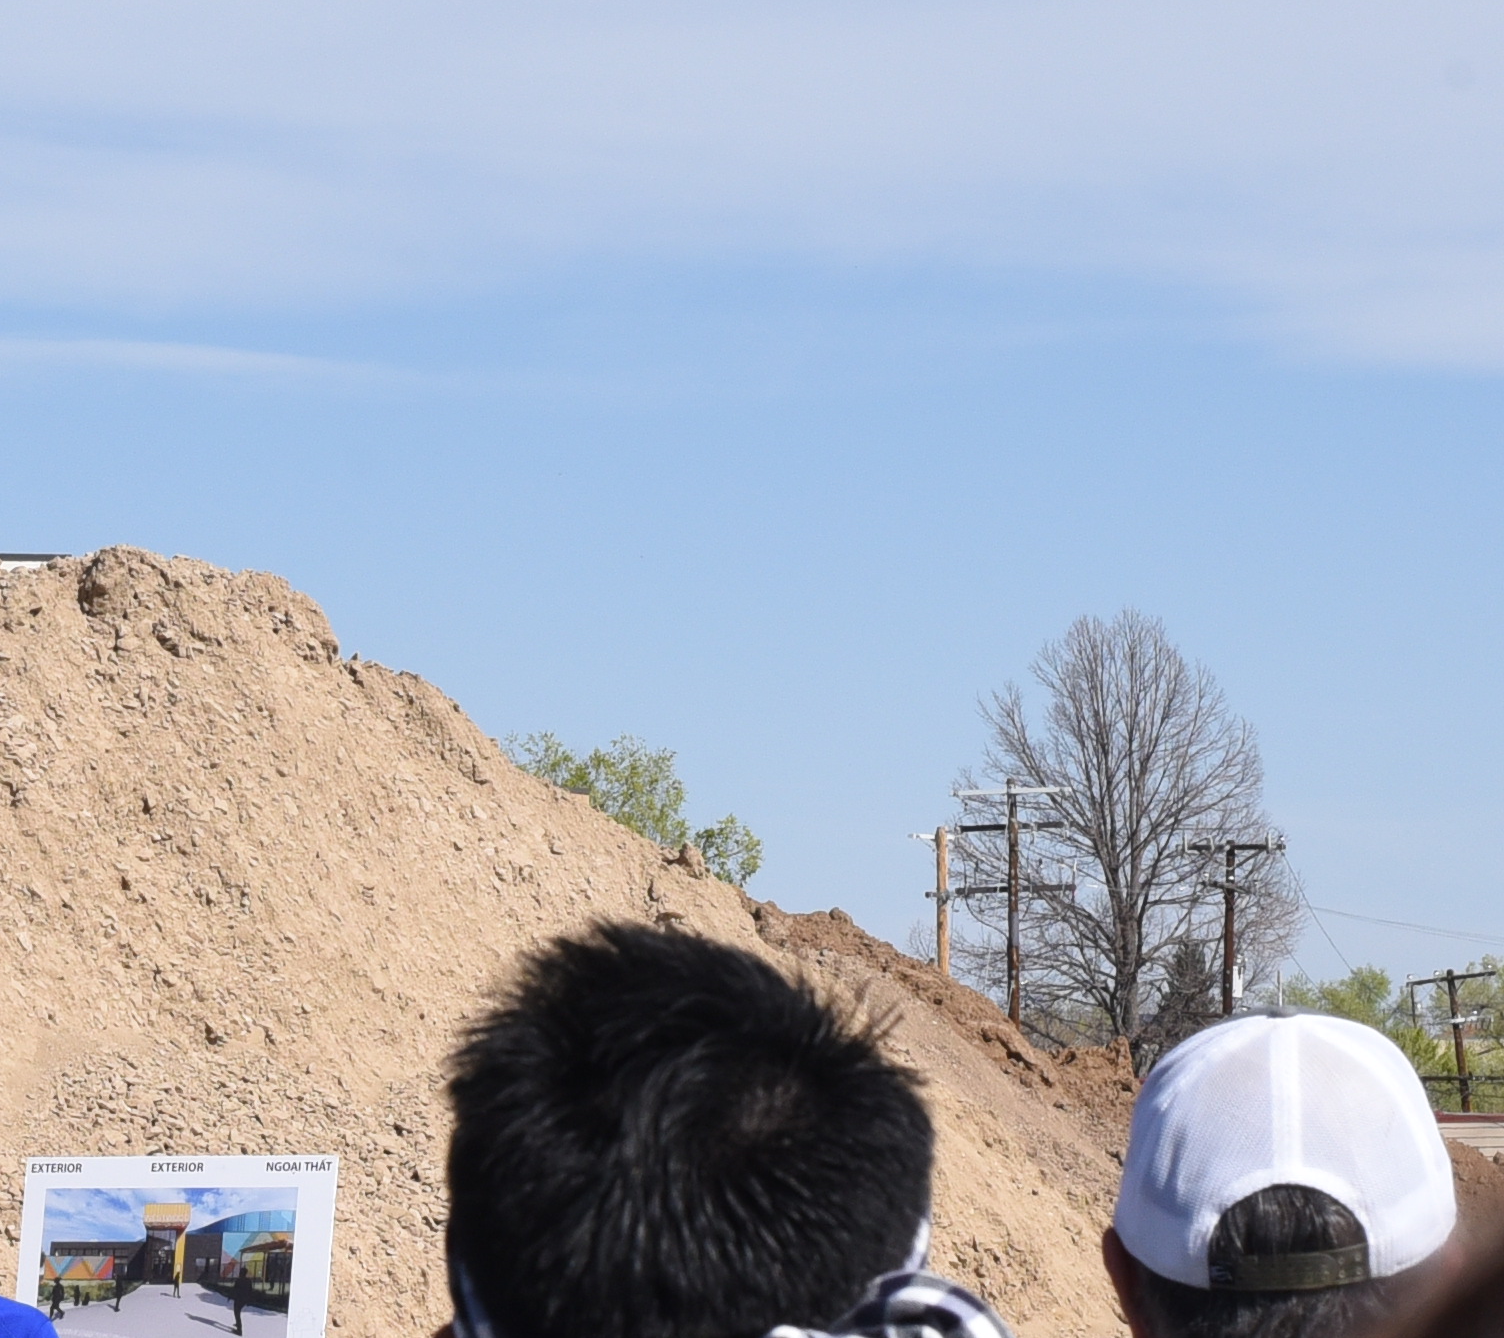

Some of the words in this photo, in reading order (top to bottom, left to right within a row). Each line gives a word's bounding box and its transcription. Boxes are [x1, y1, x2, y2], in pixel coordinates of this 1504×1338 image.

[31, 1163, 83, 1174] EXTERIOR
[150, 1162, 204, 1173] EXTERIOR
[266, 1161, 301, 1175] NGOẠI
